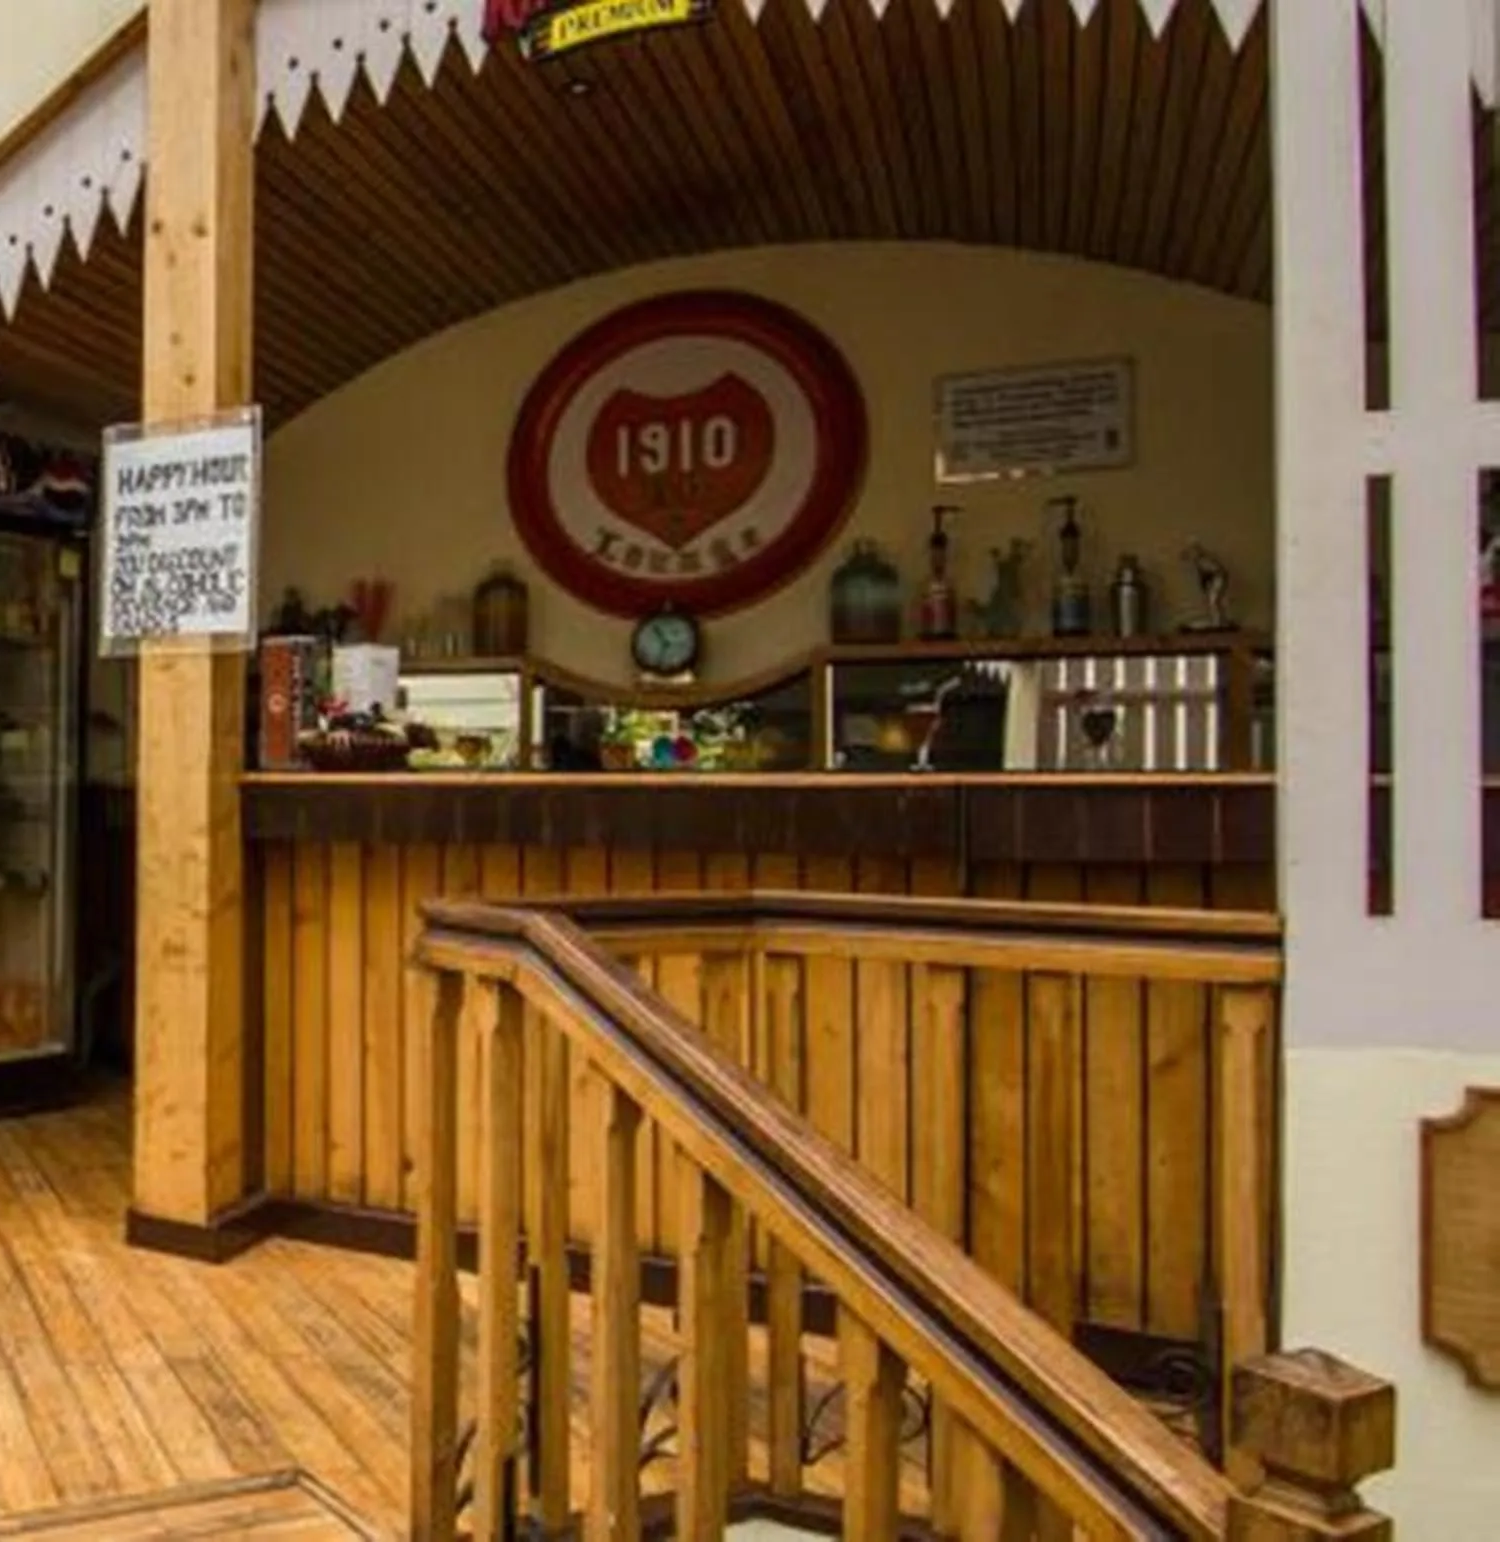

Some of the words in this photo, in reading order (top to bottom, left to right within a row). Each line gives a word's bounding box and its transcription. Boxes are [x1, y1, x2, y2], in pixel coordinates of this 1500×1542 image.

[616, 414, 737, 478] 1910
[117, 461, 186, 495] HAPPY
[190, 454, 248, 486] HOUR
[114, 503, 166, 529] FROM
[218, 491, 246, 520] TO
